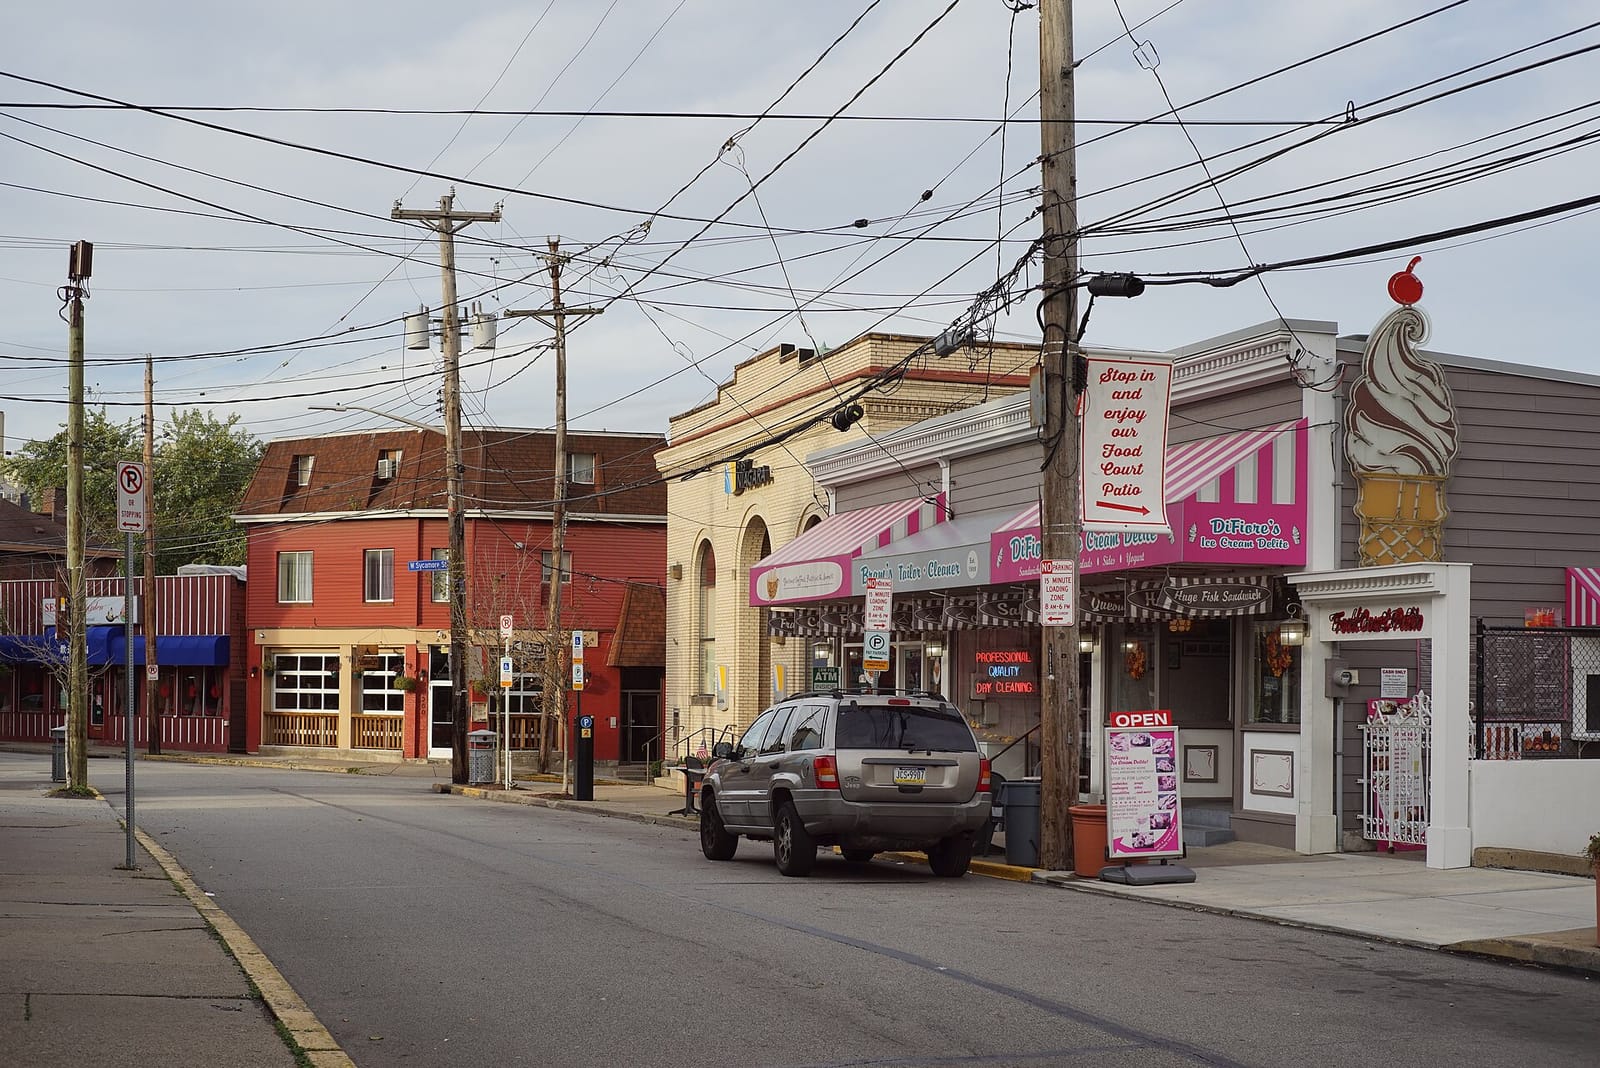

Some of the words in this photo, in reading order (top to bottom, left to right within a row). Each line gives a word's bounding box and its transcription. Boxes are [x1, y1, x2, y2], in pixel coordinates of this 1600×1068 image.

[1099, 368, 1137, 385] Stop
[1140, 369, 1156, 382] in
[1111, 388, 1142, 400] and
[1103, 407, 1147, 423] enjoy
[1111, 427, 1139, 438] our
[1102, 443, 1142, 458] Food
[1100, 461, 1143, 476] Court
[1102, 482, 1142, 497] Patio
[128, 499, 135, 507] OR
[121, 510, 142, 519] STOPPING
[1209, 517, 1281, 536] DiFiore's
[1010, 533, 1041, 562] DiFio
[1086, 532, 1120, 551] Cream
[1201, 535, 1217, 549] Ice
[1220, 536, 1255, 549] Cream
[1256, 538, 1290, 550] Delite
[415, 561, 440, 570] Sycamore
[898, 563, 922, 582] Tailor
[927, 560, 961, 579] Cleaner
[1041, 561, 1052, 573] NO
[867, 579, 876, 589] NO
[1044, 577, 1050, 585] 15
[1046, 585, 1069, 593] LOADING
[1050, 594, 1065, 602] ZONE
[1174, 589, 1198, 604] Huge
[1201, 590, 1220, 602] Fish
[1222, 588, 1262, 602] Sandwich
[997, 602, 1022, 616] Sal
[976, 651, 1031, 663] PROFESSIONAL
[814, 671, 838, 681] ATM
[988, 665, 1020, 677] QUALITY
[976, 682, 992, 693] DRY
[995, 681, 1033, 693] CLEANING
[1115, 712, 1168, 727] OPEN
